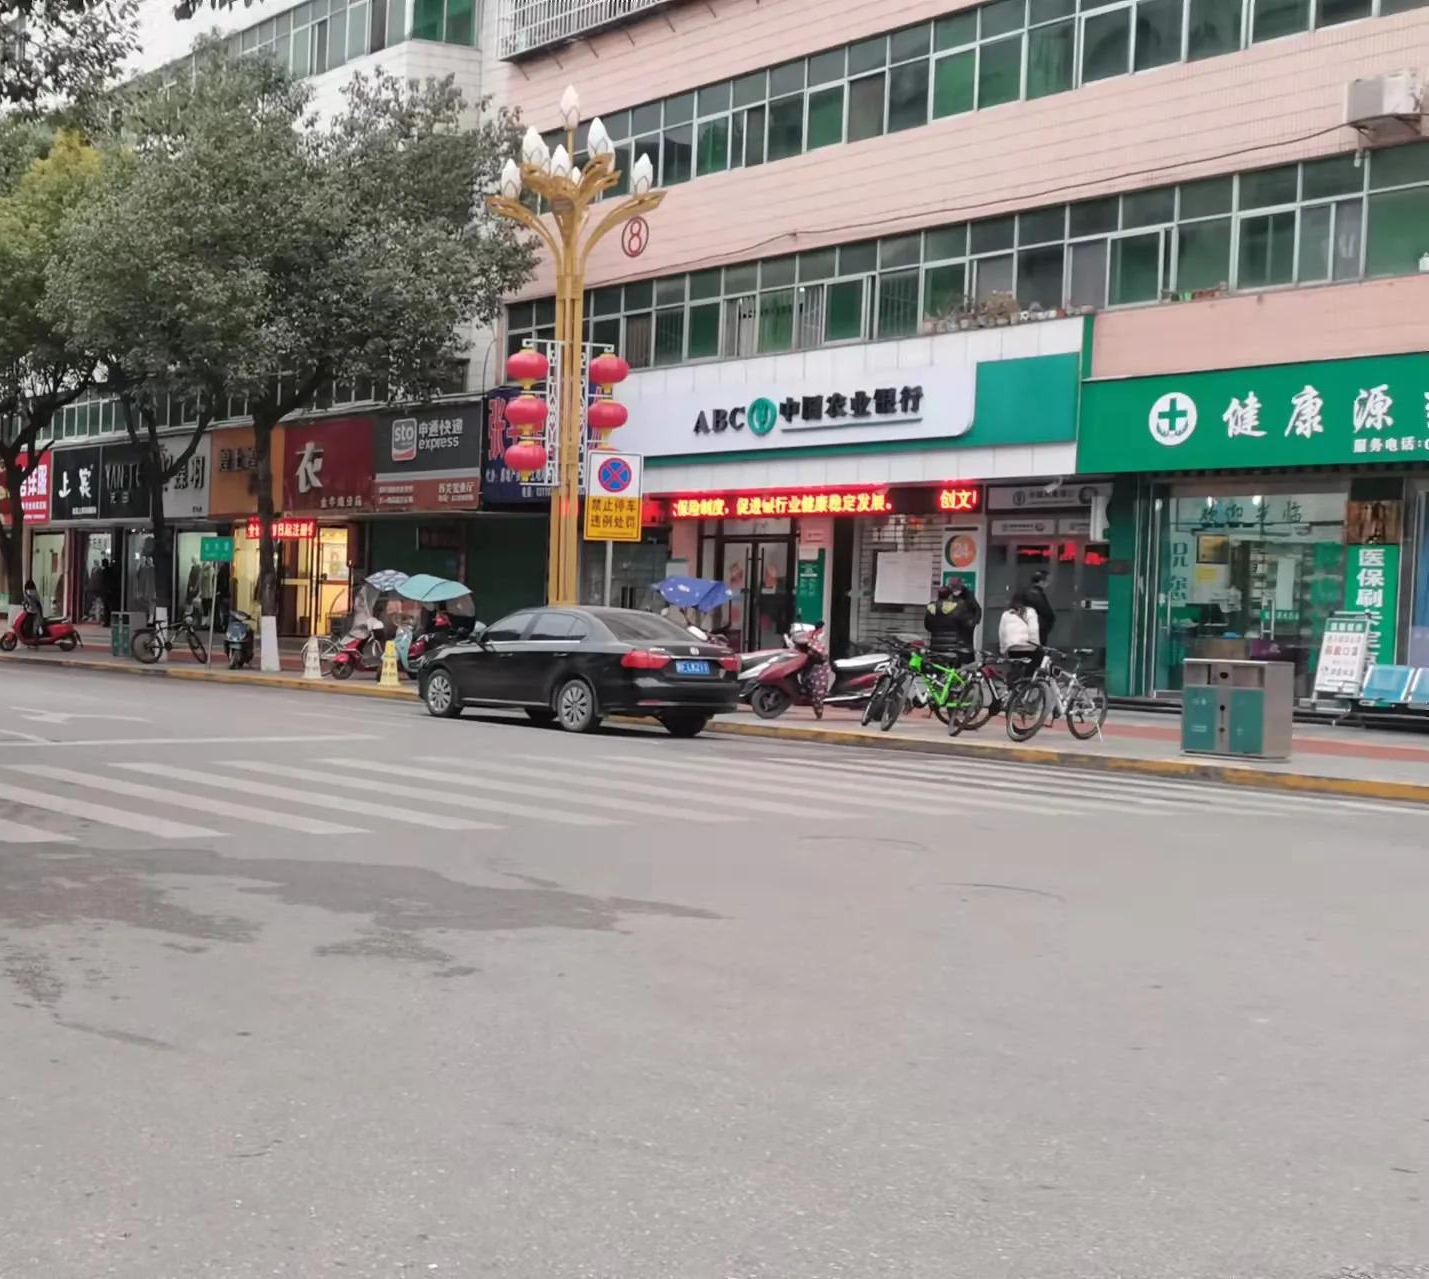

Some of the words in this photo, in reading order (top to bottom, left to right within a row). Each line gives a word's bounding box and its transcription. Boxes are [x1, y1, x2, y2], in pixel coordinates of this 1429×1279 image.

[779, 385, 924, 423] 中国农业银行
[418, 418, 463, 438] 申通快递
[693, 407, 746, 434] ABC
[394, 423, 414, 442] sto
[418, 436, 459, 452] express
[295, 442, 324, 493] 衣
[591, 498, 636, 512] 禁止停车
[940, 489, 977, 509] 创文
